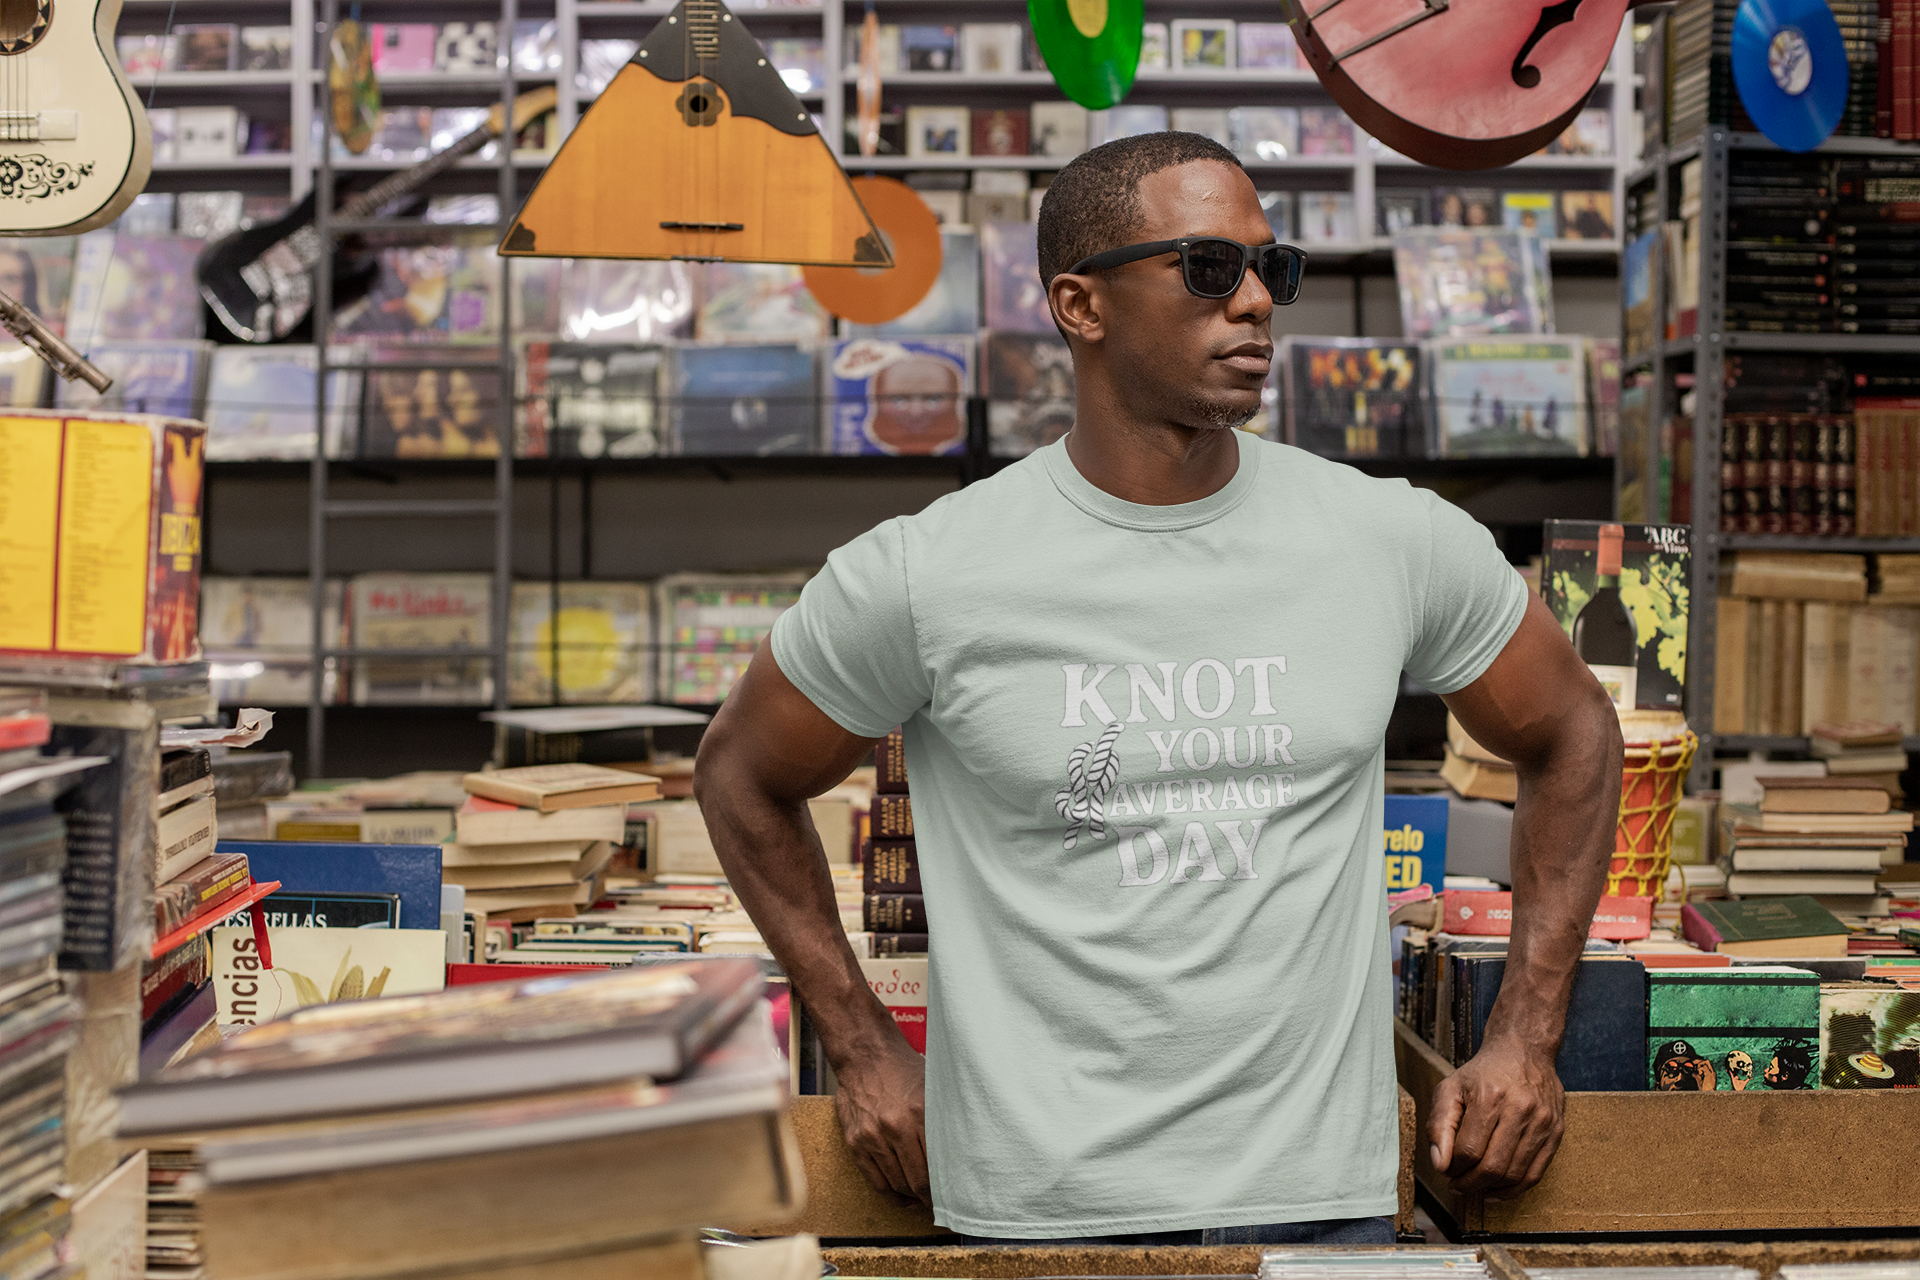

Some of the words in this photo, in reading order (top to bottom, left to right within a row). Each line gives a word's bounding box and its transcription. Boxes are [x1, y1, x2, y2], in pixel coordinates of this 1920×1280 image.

[1060, 656, 1287, 727] KNOT
[1144, 723, 1297, 773] YOUR
[881, 797, 889, 835] AMADO
[1108, 772, 1299, 818] AVERAGE
[873, 847, 882, 884] AMADO
[1113, 818, 1270, 888] DAY
